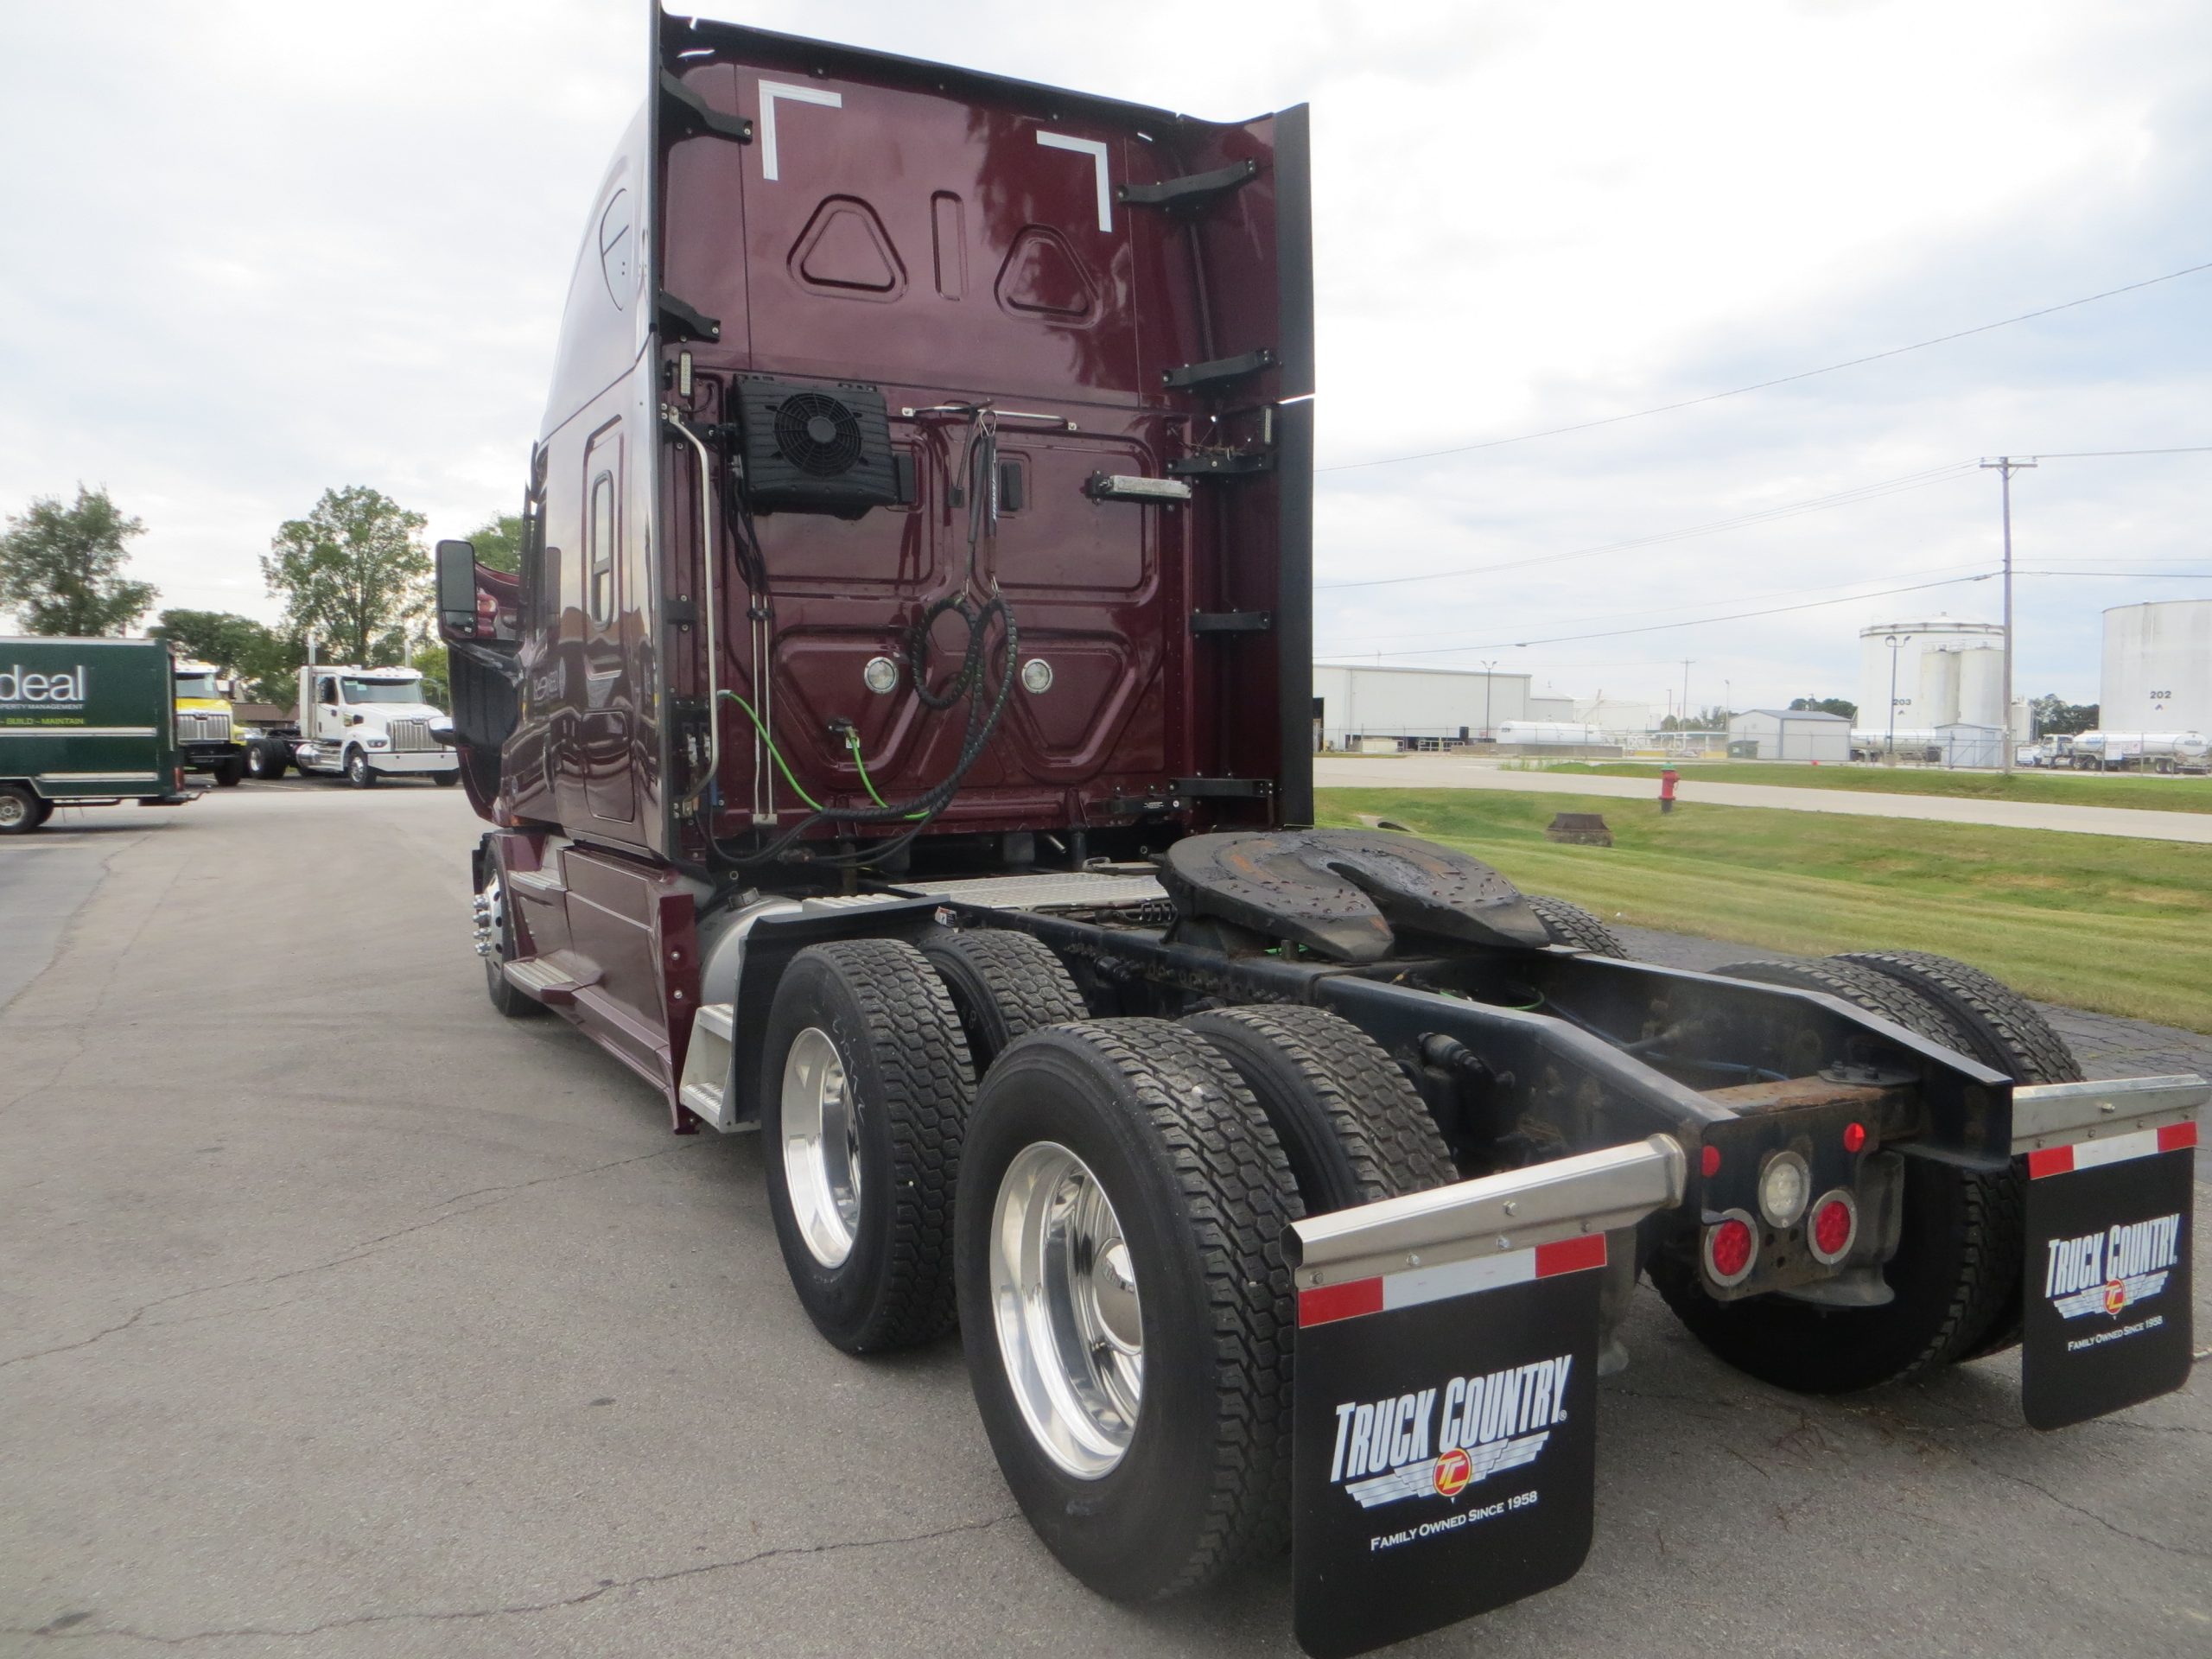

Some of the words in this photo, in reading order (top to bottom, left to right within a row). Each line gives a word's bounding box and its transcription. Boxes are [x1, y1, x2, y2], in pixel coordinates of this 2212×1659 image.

[2150, 690, 2171, 699] 202
[2045, 1231, 2105, 1298] TRUCK
[2106, 1213, 2180, 1281] COUNTRY
[2068, 1337, 2095, 1351] FAMILY
[2095, 1328, 2123, 1344] OWNED
[2124, 1322, 2145, 1335] SINCE
[2145, 1315, 2163, 1329] 1958
[1330, 1388, 1438, 1484] TRUCK
[1439, 1354, 1573, 1453] COUNTRY
[1370, 1528, 1417, 1551] FAMILY
[1419, 1514, 1466, 1537] OWNED
[1468, 1502, 1504, 1523] SINCE
[1507, 1491, 1538, 1510] 1958
